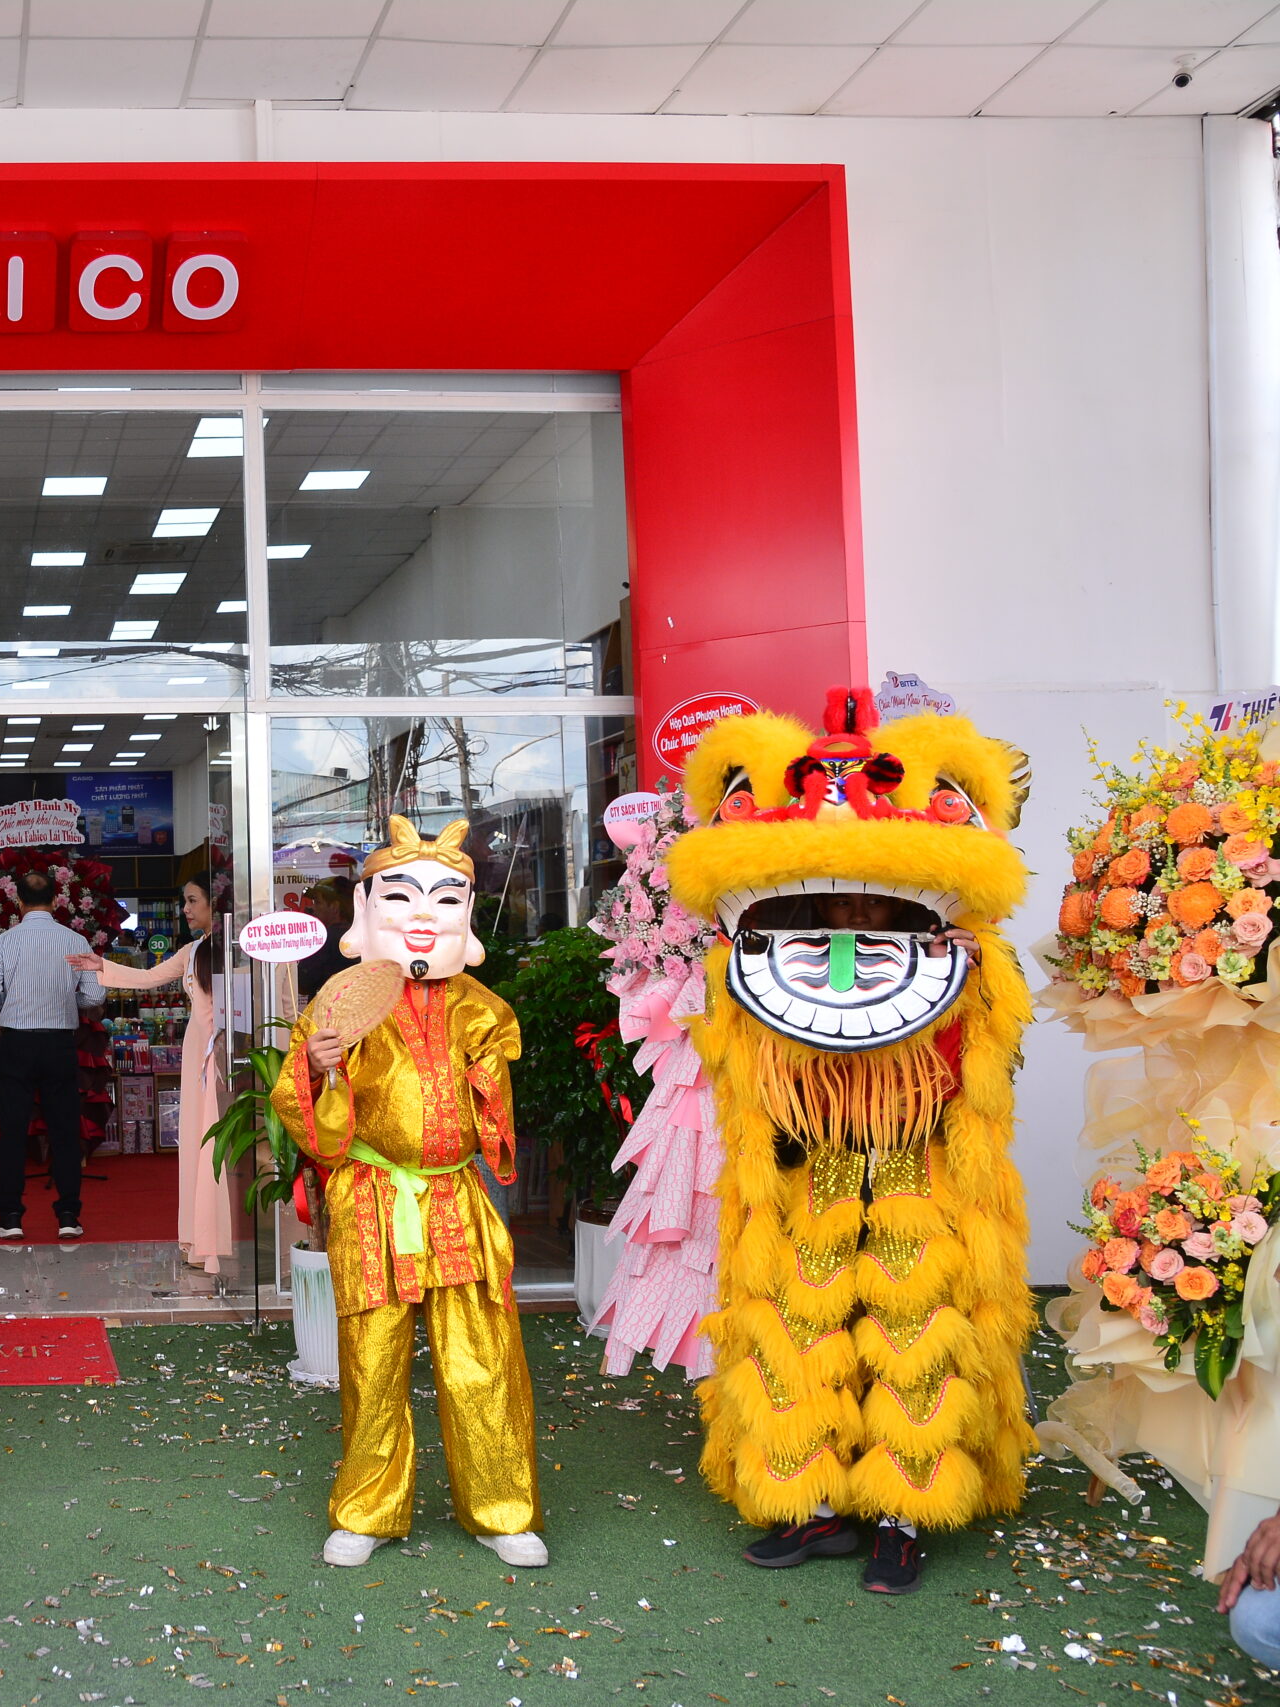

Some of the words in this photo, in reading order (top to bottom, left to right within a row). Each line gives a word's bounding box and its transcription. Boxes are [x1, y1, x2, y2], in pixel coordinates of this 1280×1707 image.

[900, 680, 919, 688] BITEX
[669, 718, 682, 731] Hộp
[682, 713, 696, 727] Quà
[660, 736, 679, 752] Chúc
[34, 801, 61, 814] Hạnh
[610, 807, 620, 818] CTY
[621, 803, 636, 816] SÁCH
[35, 814, 51, 825] khai
[6, 832, 23, 845] Sách
[24, 830, 47, 843] Fabico
[247, 925, 261, 938] CTY
[264, 922, 286, 937] SÁCH
[288, 922, 307, 934] ĐINH
[309, 921, 317, 934] TỊ
[151, 941, 164, 950] 30
